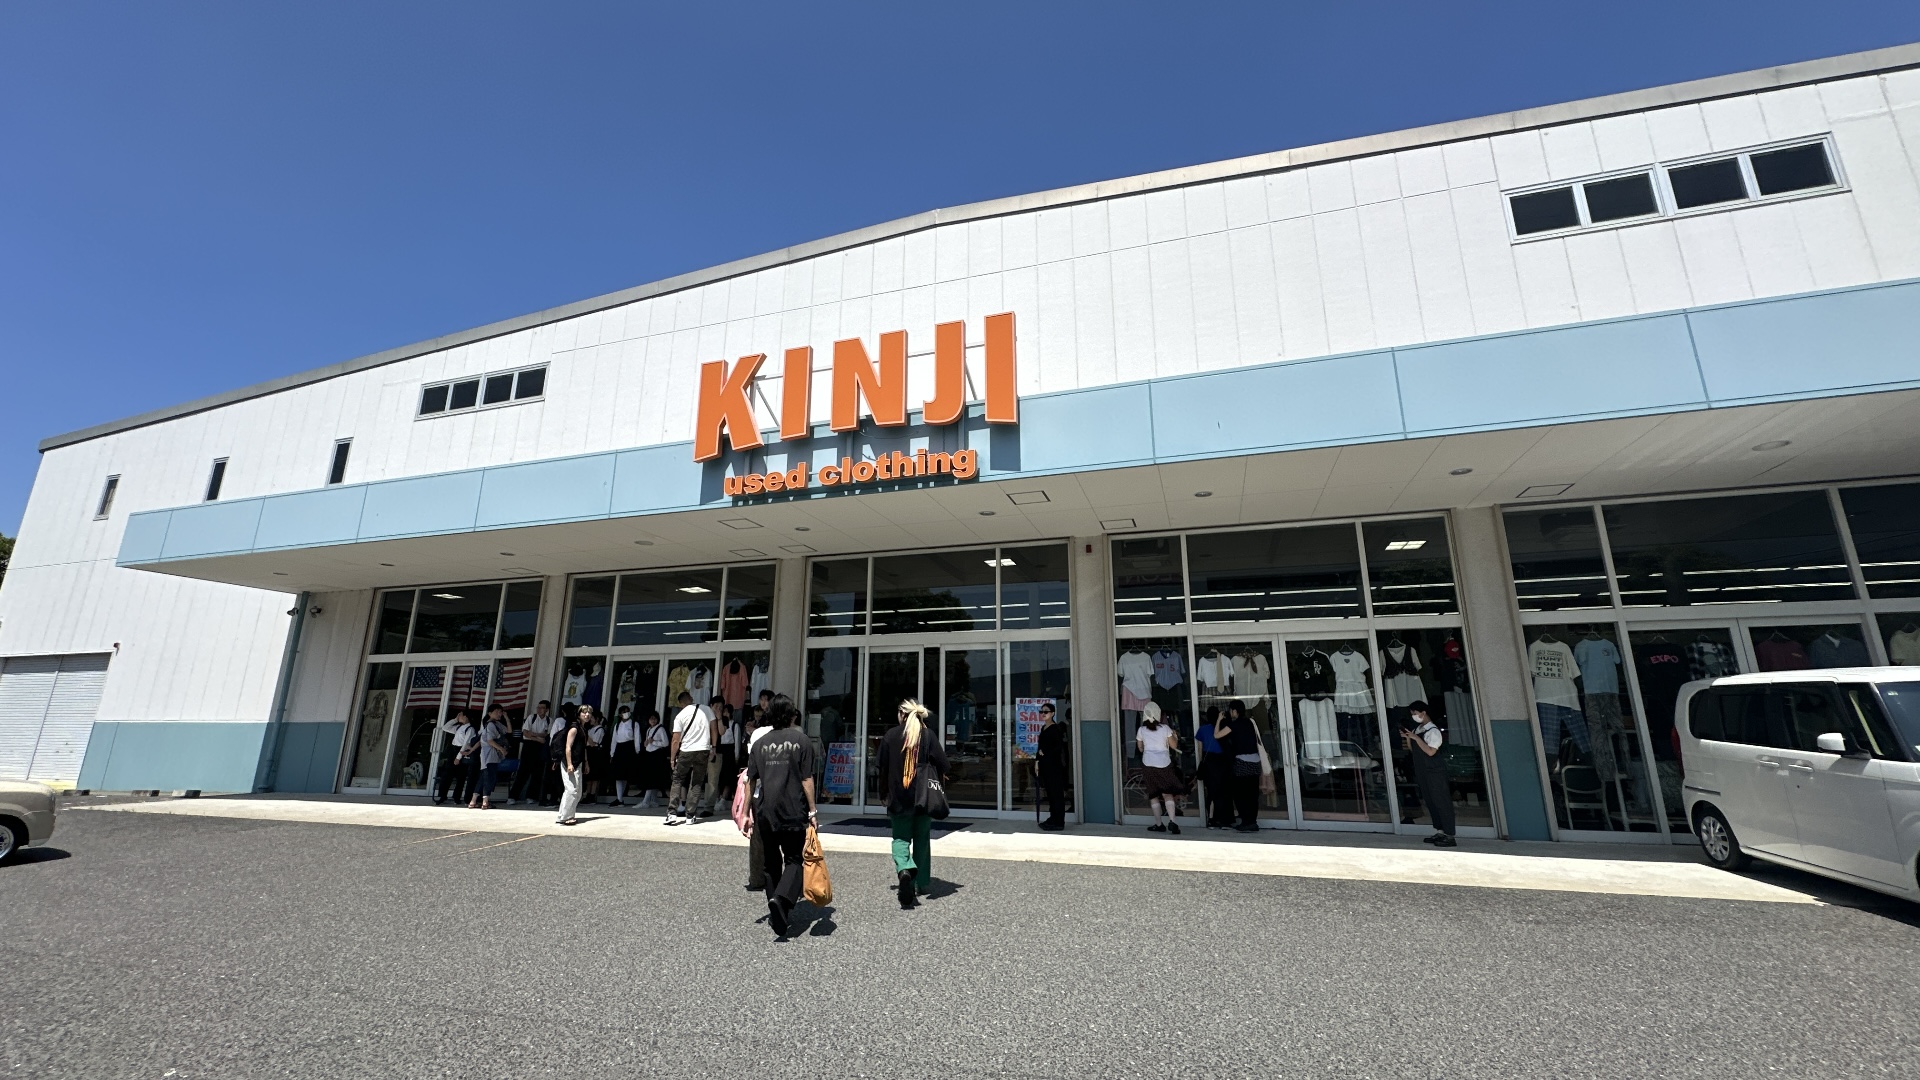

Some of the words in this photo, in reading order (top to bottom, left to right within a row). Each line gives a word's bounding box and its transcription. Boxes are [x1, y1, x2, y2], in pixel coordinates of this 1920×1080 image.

[694, 311, 1018, 463] KINJI
[724, 462, 808, 496] used
[818, 448, 977, 486] clothing
[1650, 654, 1679, 664] EXPO
[1303, 670, 1311, 679] 3
[1019, 711, 1046, 722] SAL
